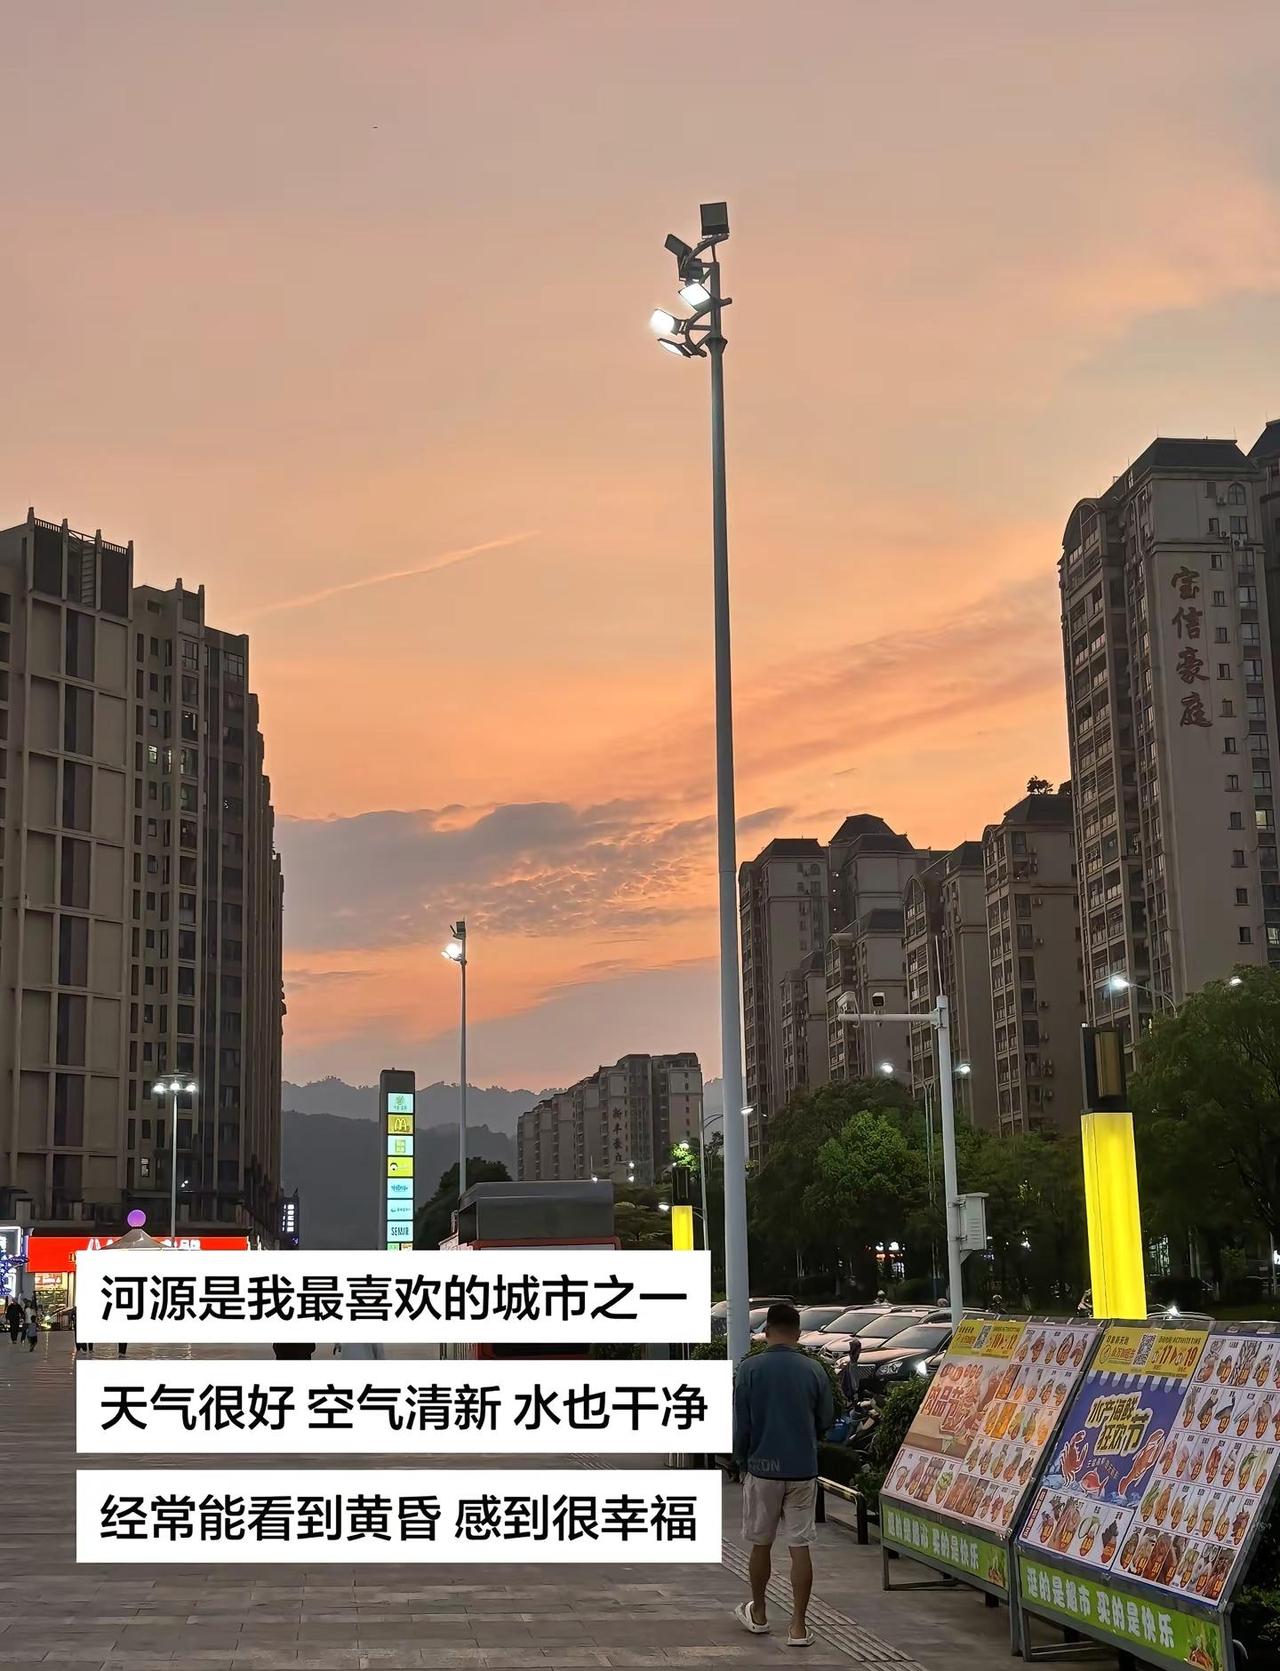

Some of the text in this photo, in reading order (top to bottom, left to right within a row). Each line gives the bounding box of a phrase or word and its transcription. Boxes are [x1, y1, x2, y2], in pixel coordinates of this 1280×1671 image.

[1171, 566, 1213, 728] 宝信豪庭
[1088, 1396, 1139, 1423] 水产海鲜
[1096, 1413, 1150, 1452] 狂欢节
[1095, 1590, 1175, 1649] 买的是快乐
